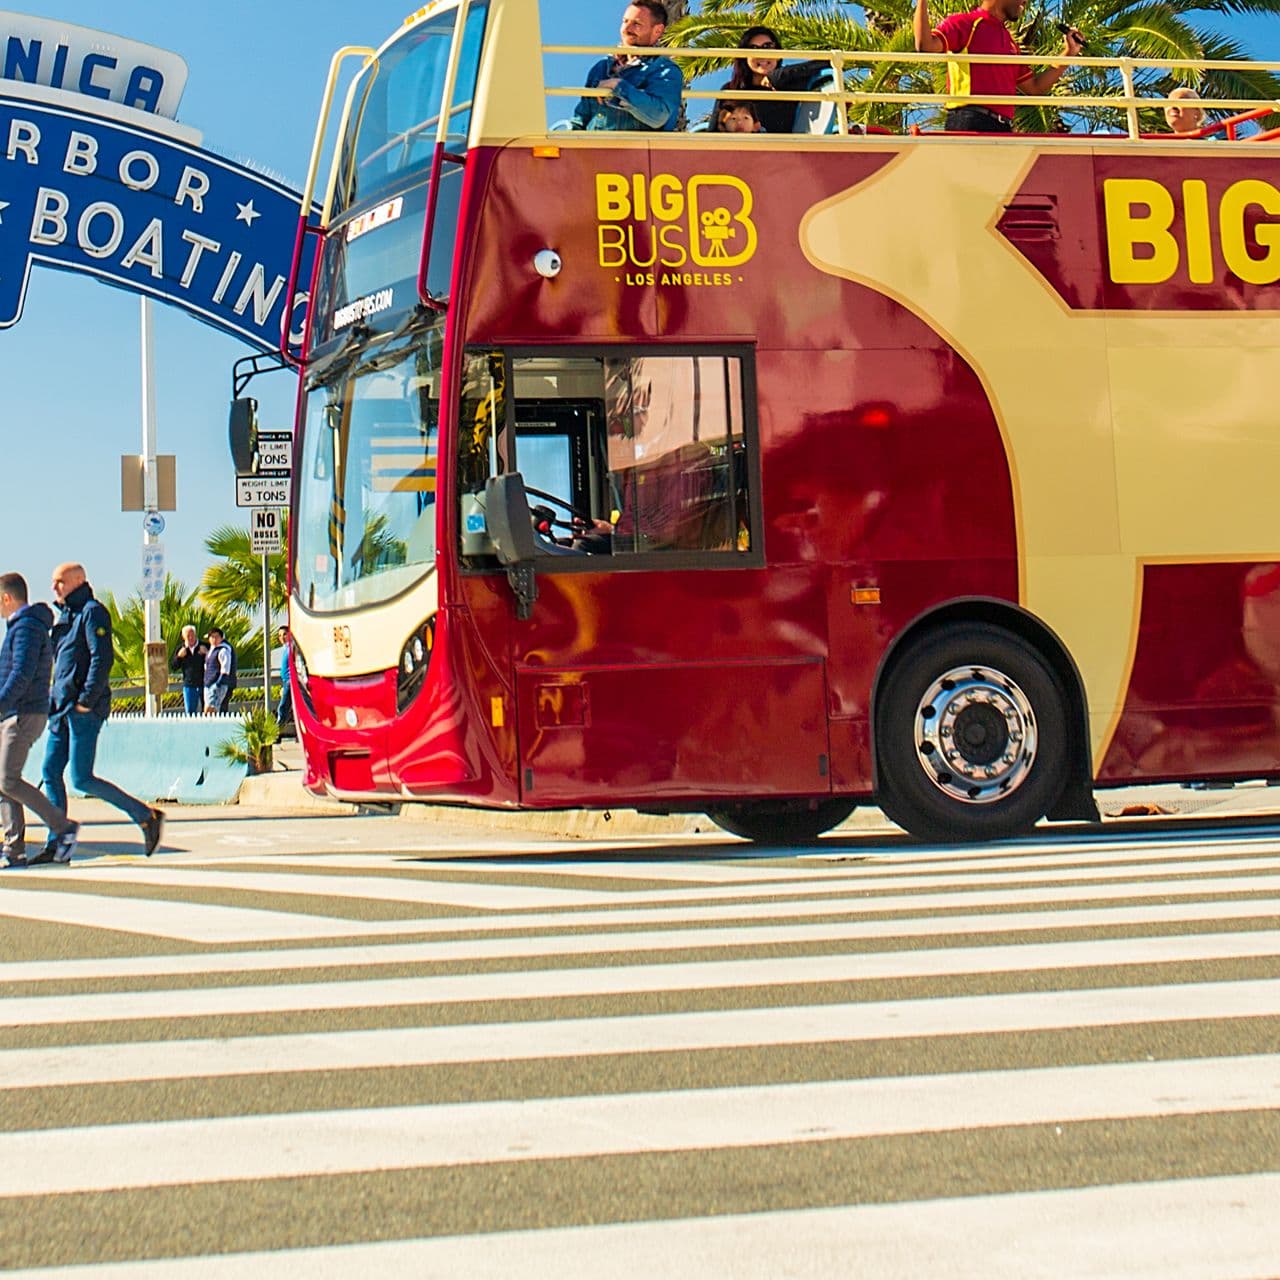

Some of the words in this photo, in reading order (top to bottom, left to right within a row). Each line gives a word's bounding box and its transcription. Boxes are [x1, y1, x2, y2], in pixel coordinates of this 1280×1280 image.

[596, 173, 684, 221] BIG
[598, 224, 687, 267] BUS
[29, 186, 312, 345] BOATING
[626, 273, 655, 286] LOS
[661, 273, 733, 286] ANGELES
[244, 491, 252, 501] 3
[256, 491, 286, 501] TONS
[256, 513, 276, 528] NO
[253, 530, 279, 539] BUSES
